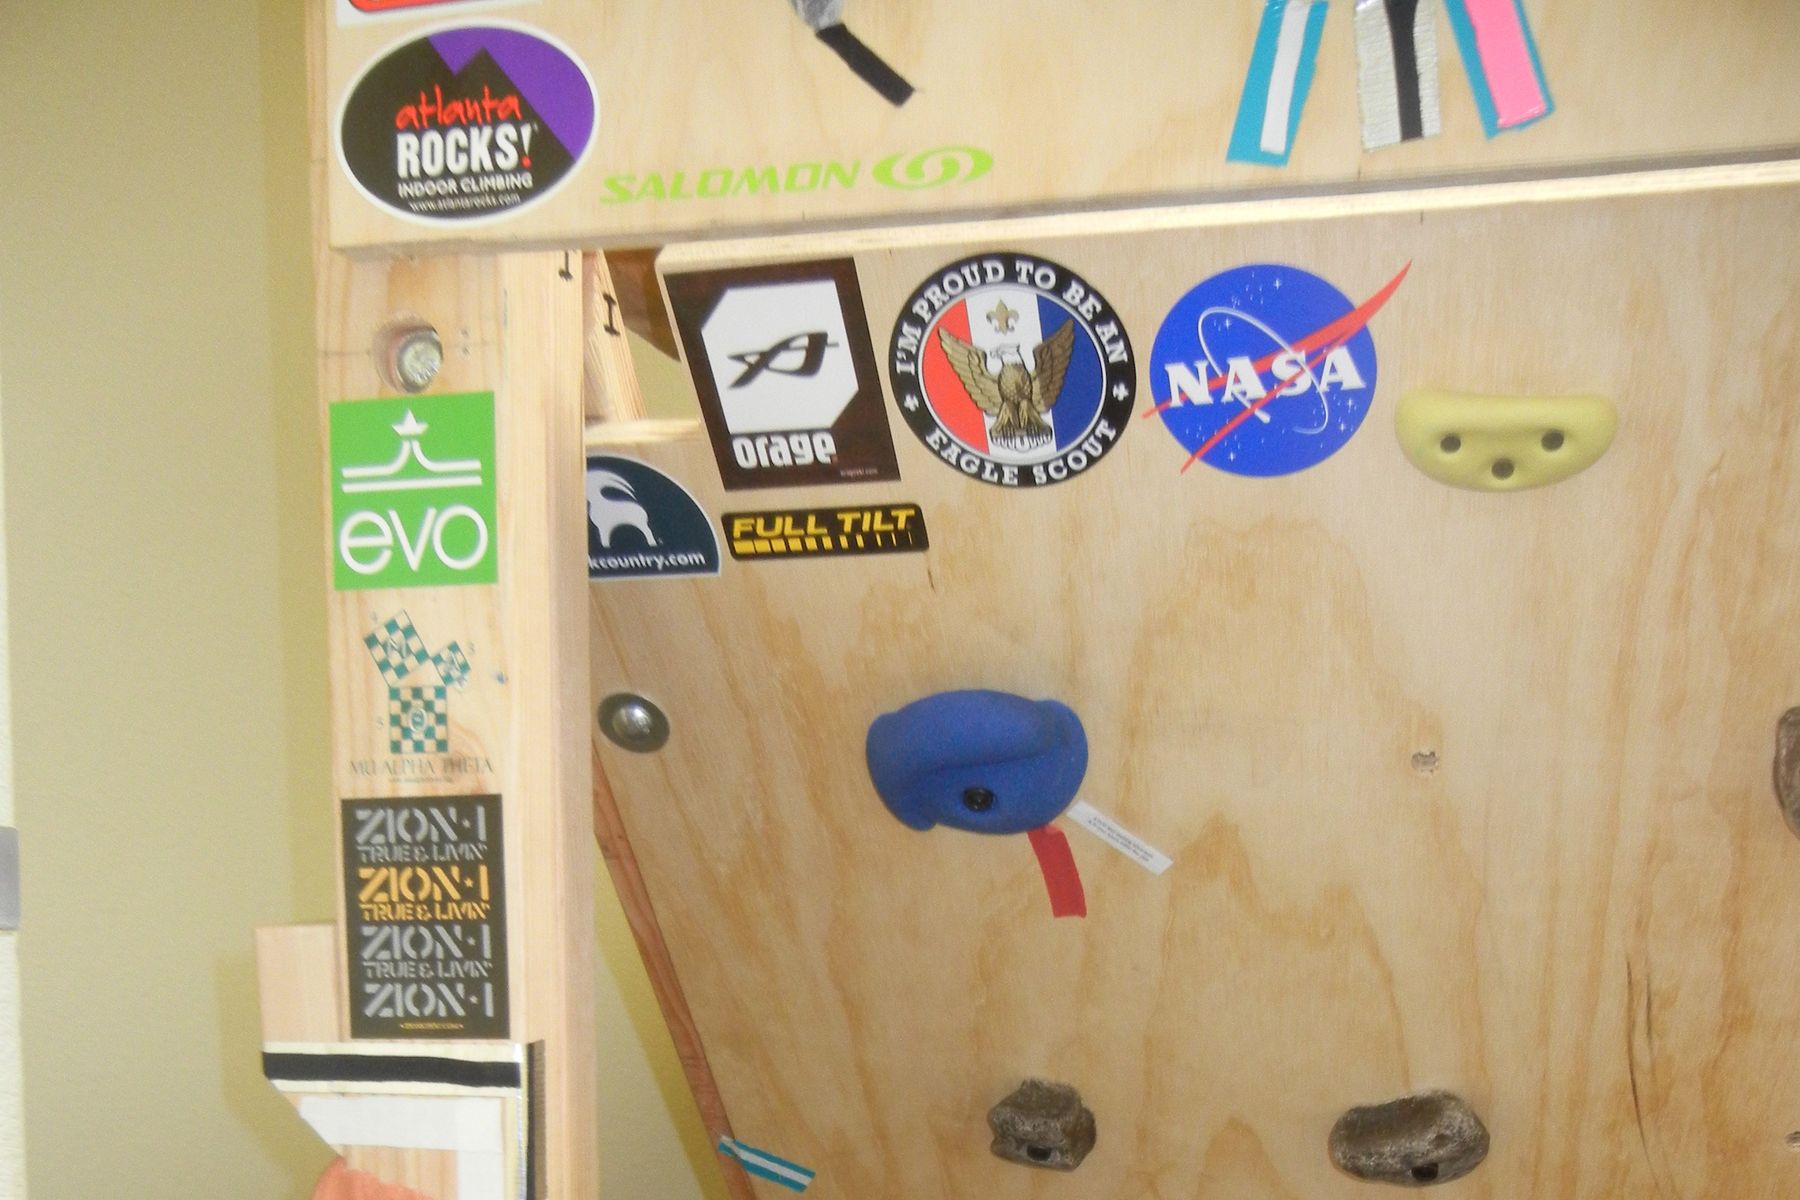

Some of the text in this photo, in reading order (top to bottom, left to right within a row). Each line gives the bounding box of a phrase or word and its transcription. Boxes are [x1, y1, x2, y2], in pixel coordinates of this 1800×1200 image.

[395, 83, 523, 130] atlanta
[396, 122, 532, 179] ROCKS!
[398, 171, 534, 199] INDOOR CLIMBING
[600, 159, 862, 206] SALOMON
[895, 259, 1129, 375] I'M PROUD TO BE AN
[1164, 344, 1367, 408] NASA
[732, 430, 837, 470] orage
[925, 418, 1118, 487] EAGLE SCOUT
[339, 504, 489, 576] evo
[733, 508, 916, 539] FULL TILT
[356, 845, 411, 863] TRUE
[358, 903, 415, 922] TRUE
[362, 961, 418, 979] TRUE
